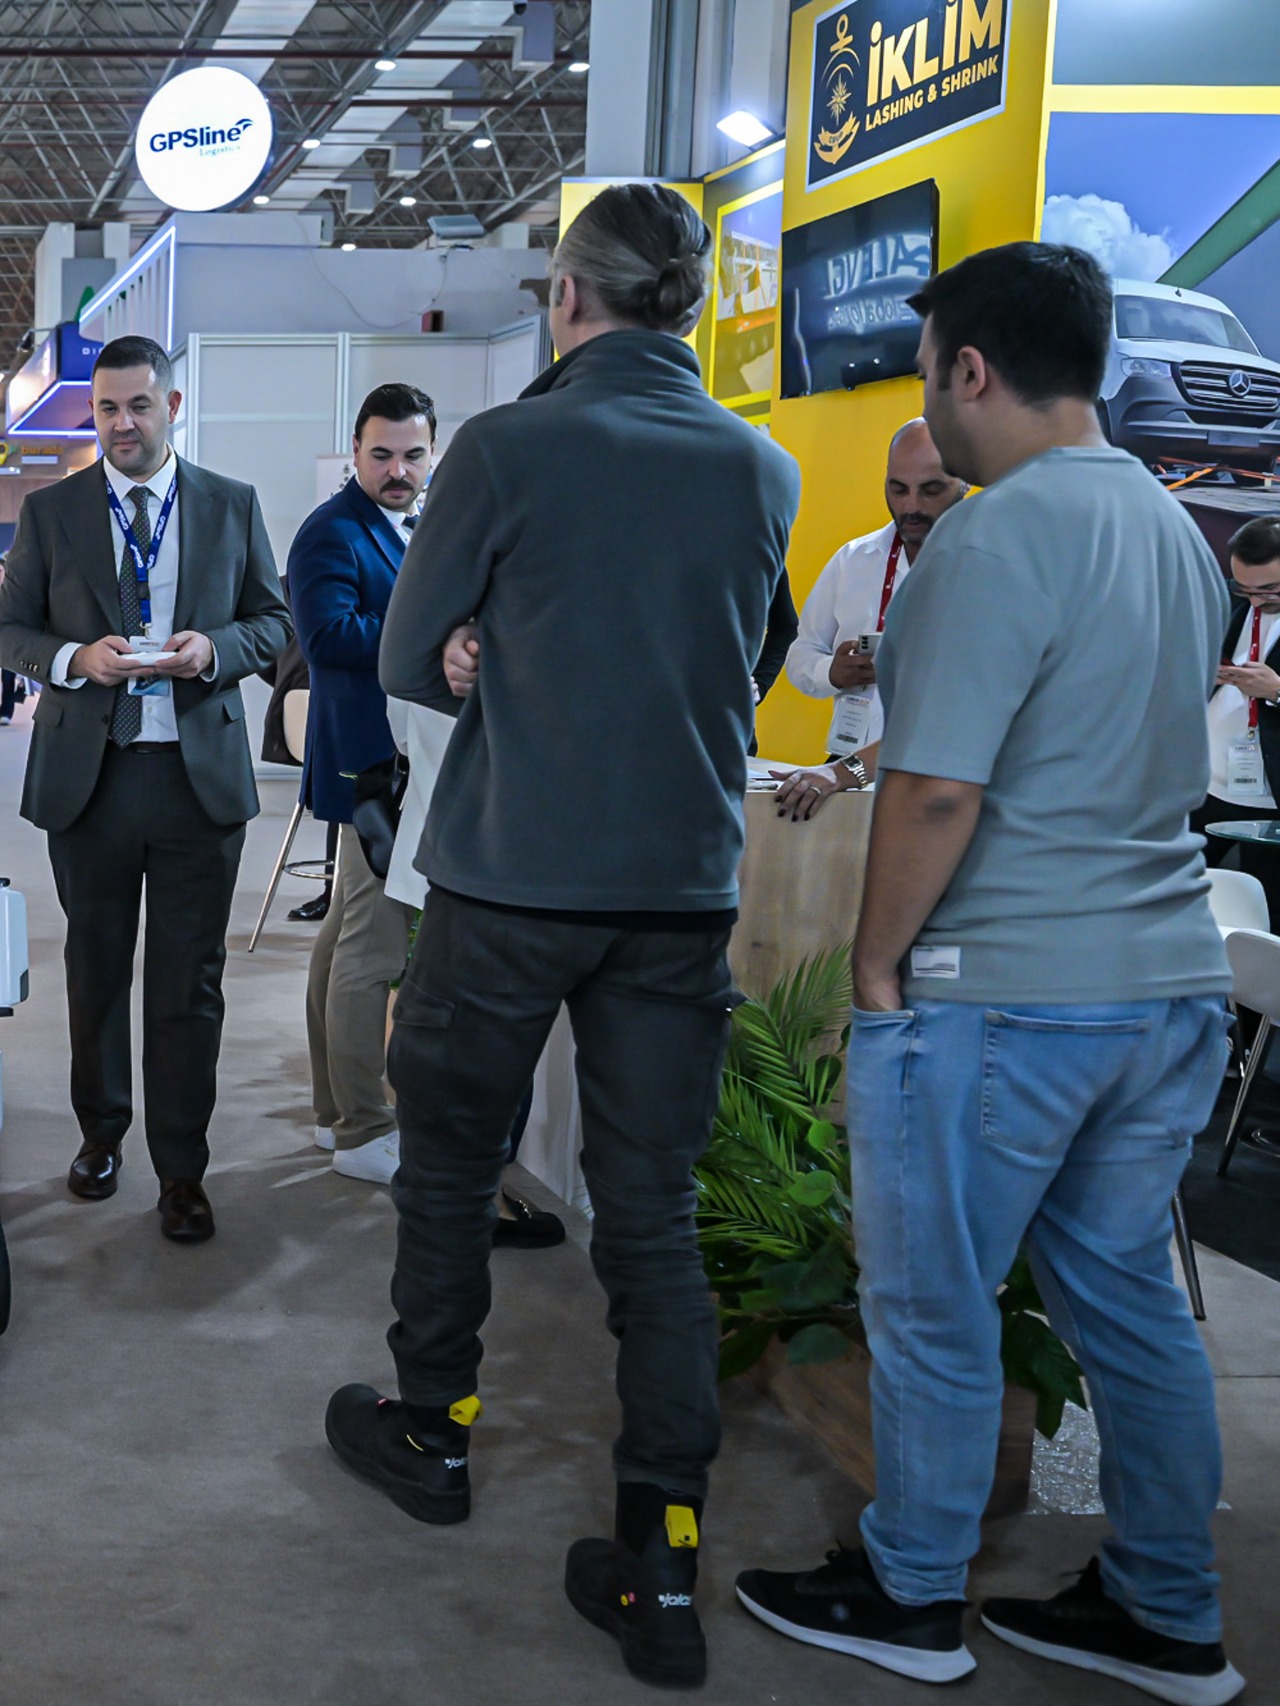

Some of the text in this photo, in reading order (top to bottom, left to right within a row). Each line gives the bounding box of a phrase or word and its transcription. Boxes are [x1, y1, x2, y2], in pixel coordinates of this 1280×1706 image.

[867, 0, 1003, 107] İKLİM
[865, 54, 1000, 132] LASHING & SHRINK
[150, 126, 242, 152] GPSline
